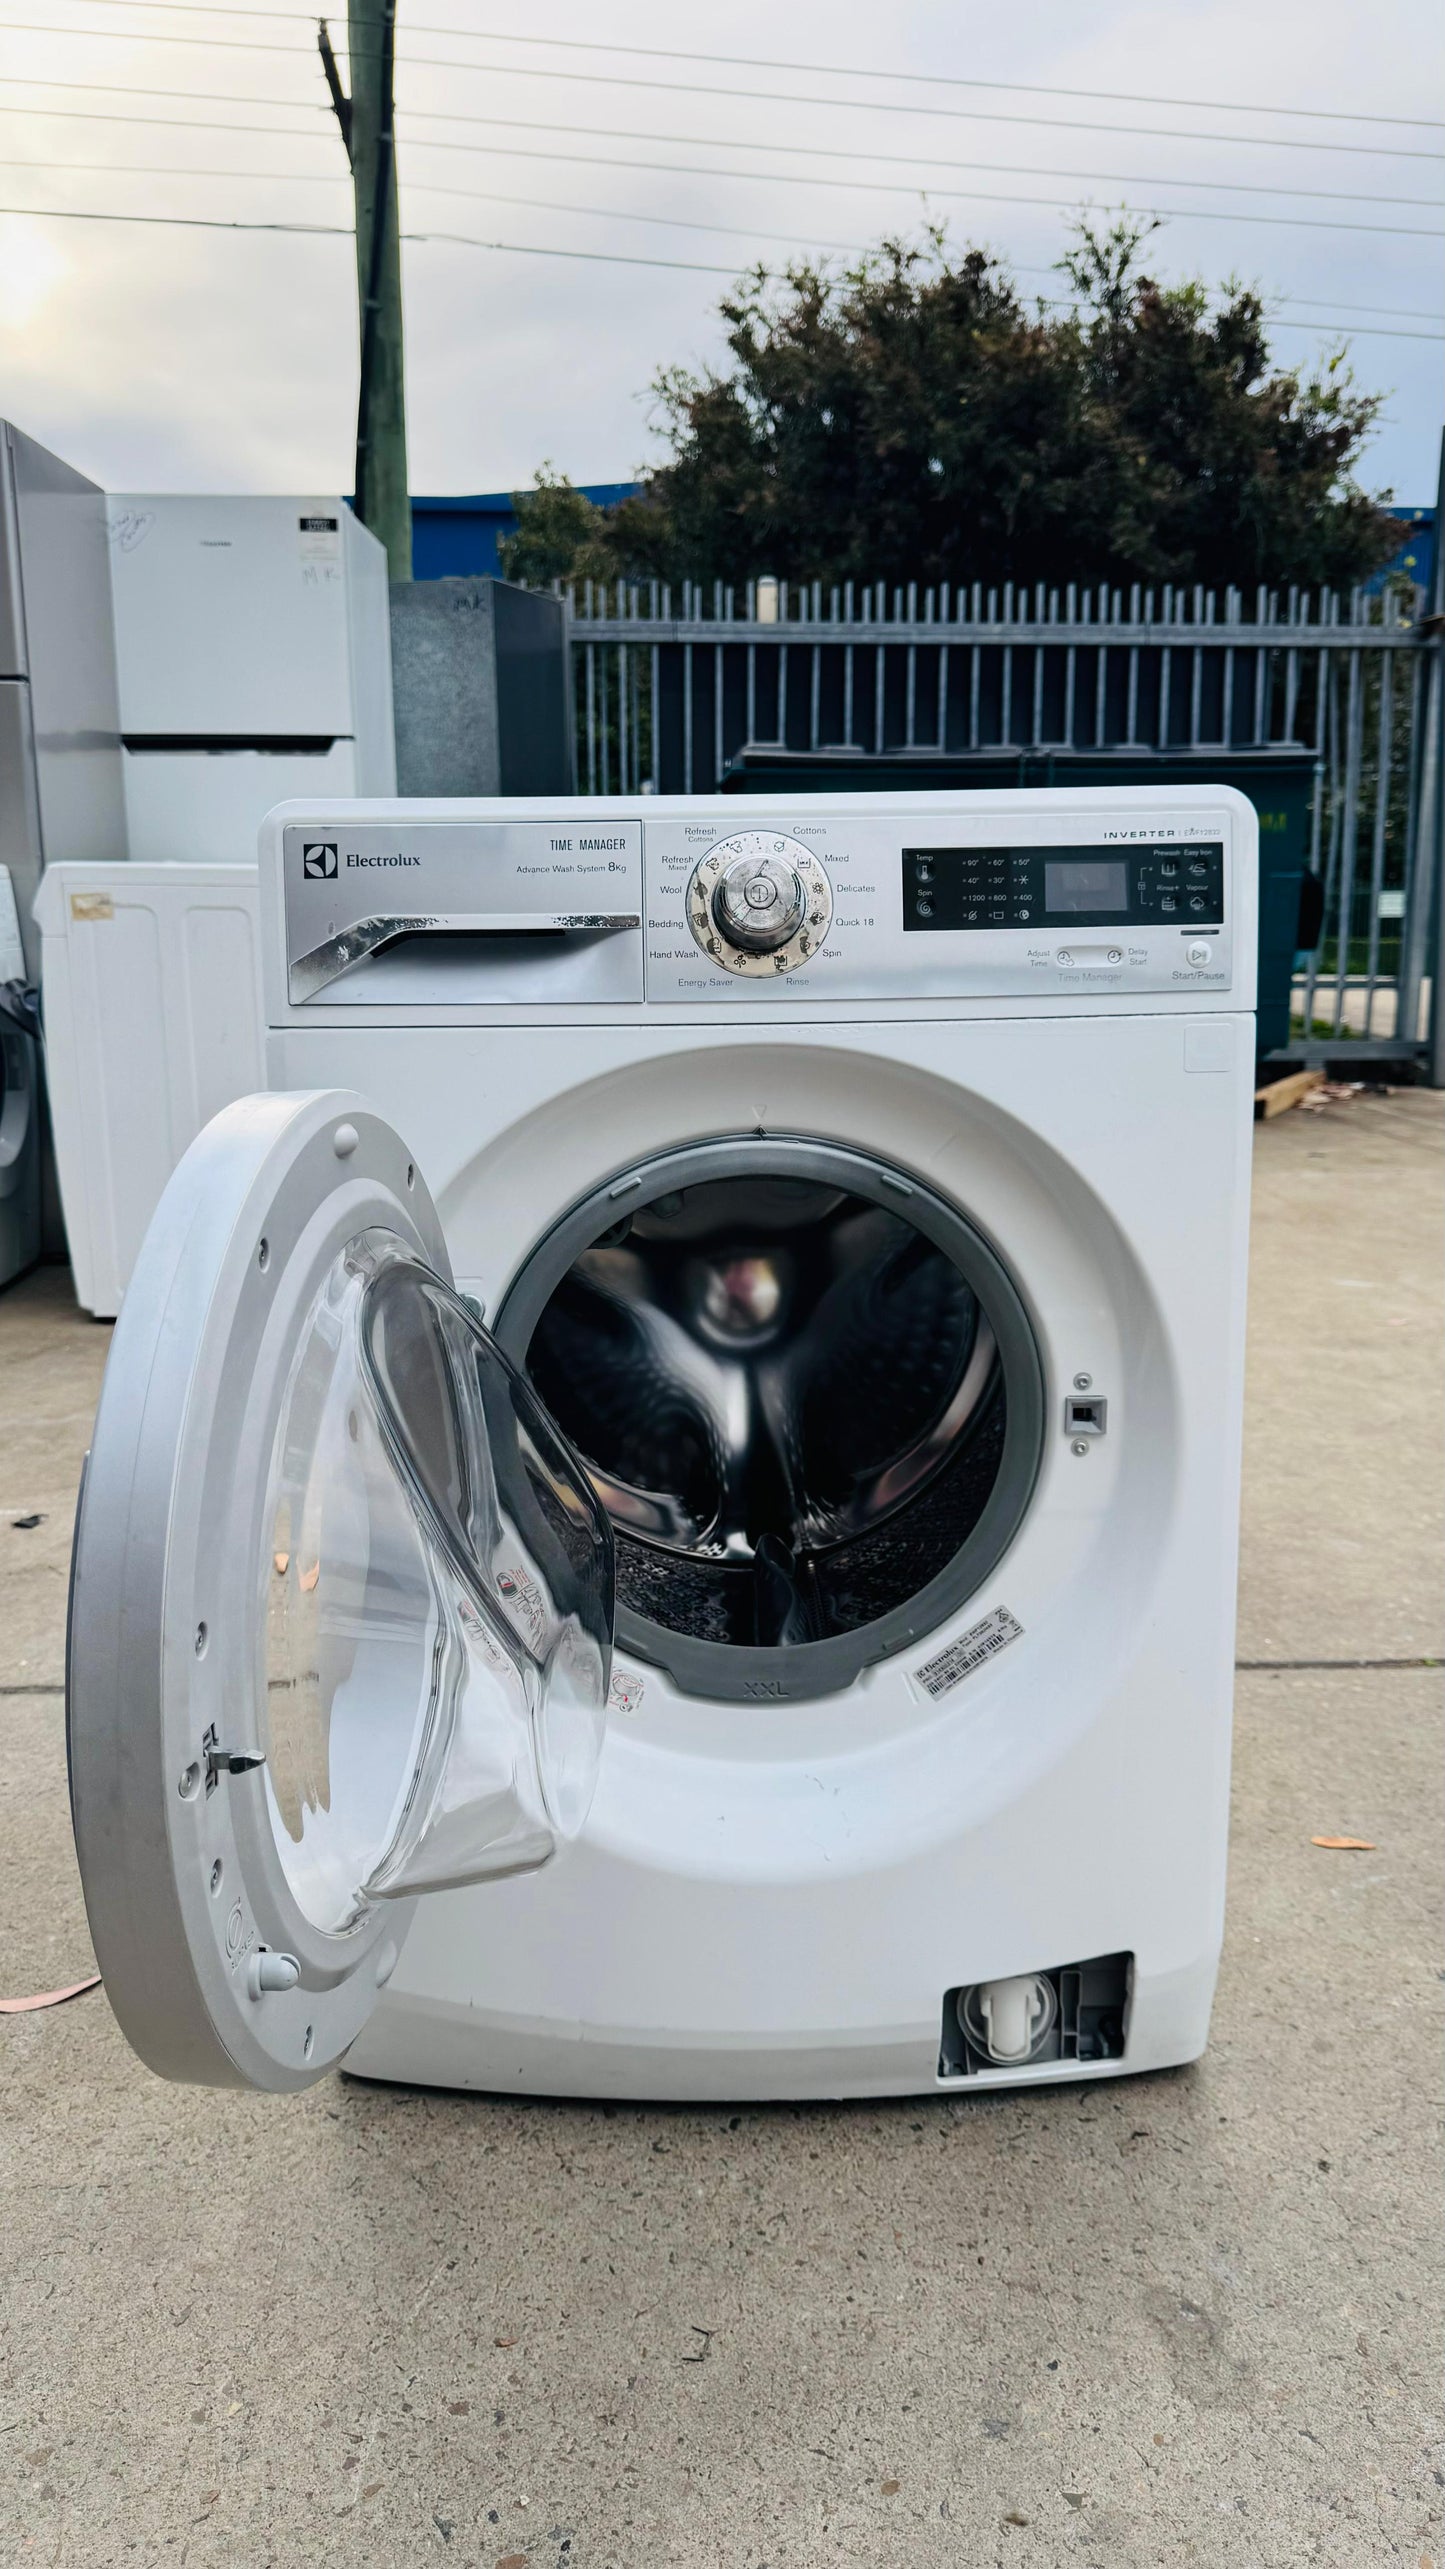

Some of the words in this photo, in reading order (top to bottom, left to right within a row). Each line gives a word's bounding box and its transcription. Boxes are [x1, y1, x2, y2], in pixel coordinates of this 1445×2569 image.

[685, 827, 717, 836] Refresh
[793, 826, 827, 835] Cottons
[1104, 830, 1176, 839] INVERTER
[550, 839, 573, 851] TIME
[579, 838, 626, 851] MANAGER
[1153, 849, 1181, 857] Prewash
[1183, 849, 1200, 857] Easy
[346, 853, 421, 868] Electrolux
[661, 855, 694, 864] Refresh
[824, 854, 849, 862] Mixed
[916, 854, 934, 862] Temp
[516, 865, 550, 874] Advance
[552, 864, 574, 873] Wash
[576, 864, 606, 874] System
[608, 861, 627, 874] 8Kg
[660, 886, 682, 894] Wool
[836, 884, 876, 893] Delicates
[1186, 884, 1208, 892] Vapour
[917, 889, 933, 897] Spin
[648, 919, 684, 929] Bedding
[835, 918, 861, 927] Quick
[864, 918, 874, 927] 18
[649, 950, 673, 959] Hand
[674, 950, 699, 959] Wash
[822, 949, 842, 958] Spin
[1027, 949, 1050, 959] Adjust
[1128, 948, 1148, 957] Delay
[1030, 960, 1048, 968] Time
[1129, 958, 1147, 966] Start
[1058, 973, 1080, 983] Time
[1081, 972, 1123, 984] Manager
[1172, 970, 1225, 981] Start/Pause
[678, 978, 708, 988] Energy
[709, 978, 734, 987] Saver
[786, 978, 810, 986] Rinse
[924, 1645, 959, 1673] Electrolux
[743, 1681, 789, 1698] XXL
